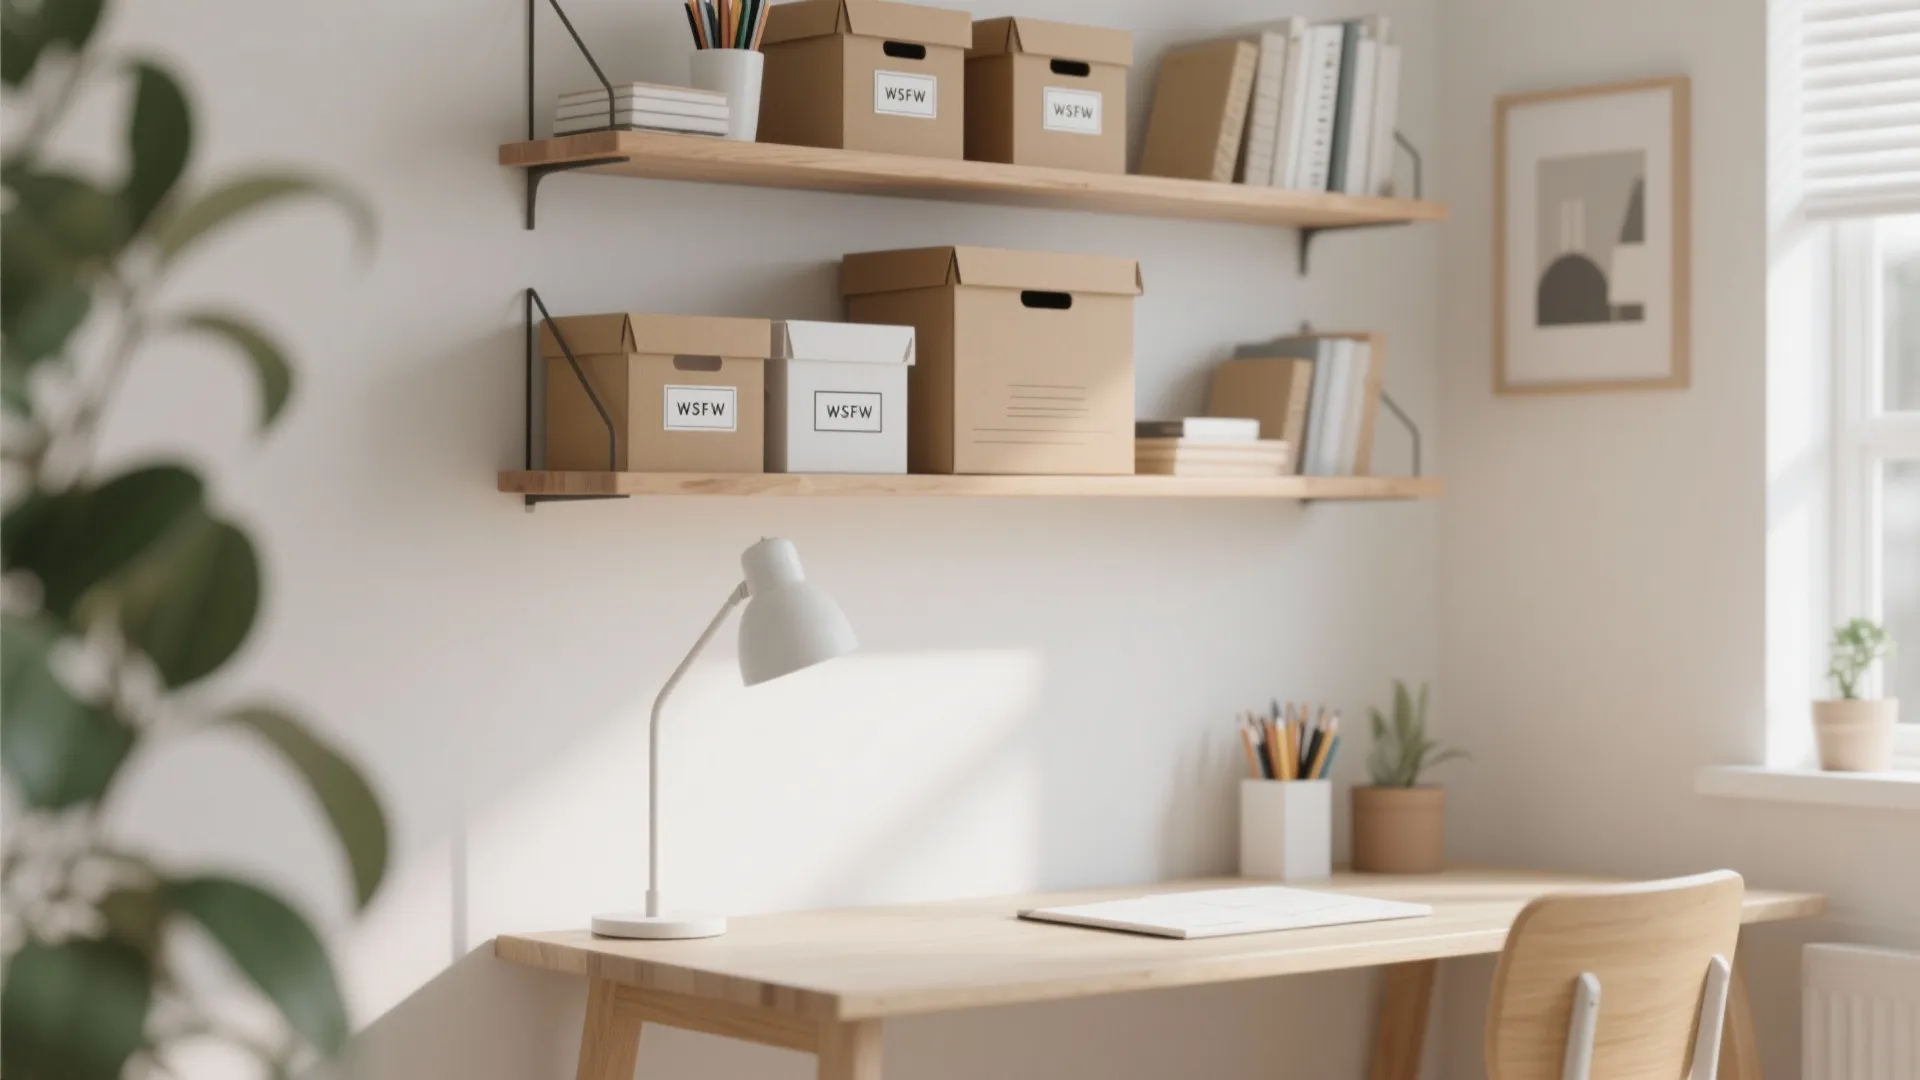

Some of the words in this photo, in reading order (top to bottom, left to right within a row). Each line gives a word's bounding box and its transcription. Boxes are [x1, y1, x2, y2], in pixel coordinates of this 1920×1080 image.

[885, 87, 926, 103] WSFW
[1054, 103, 1093, 119] WSFW
[677, 401, 725, 416] WSFW
[827, 405, 873, 418] WSFW
